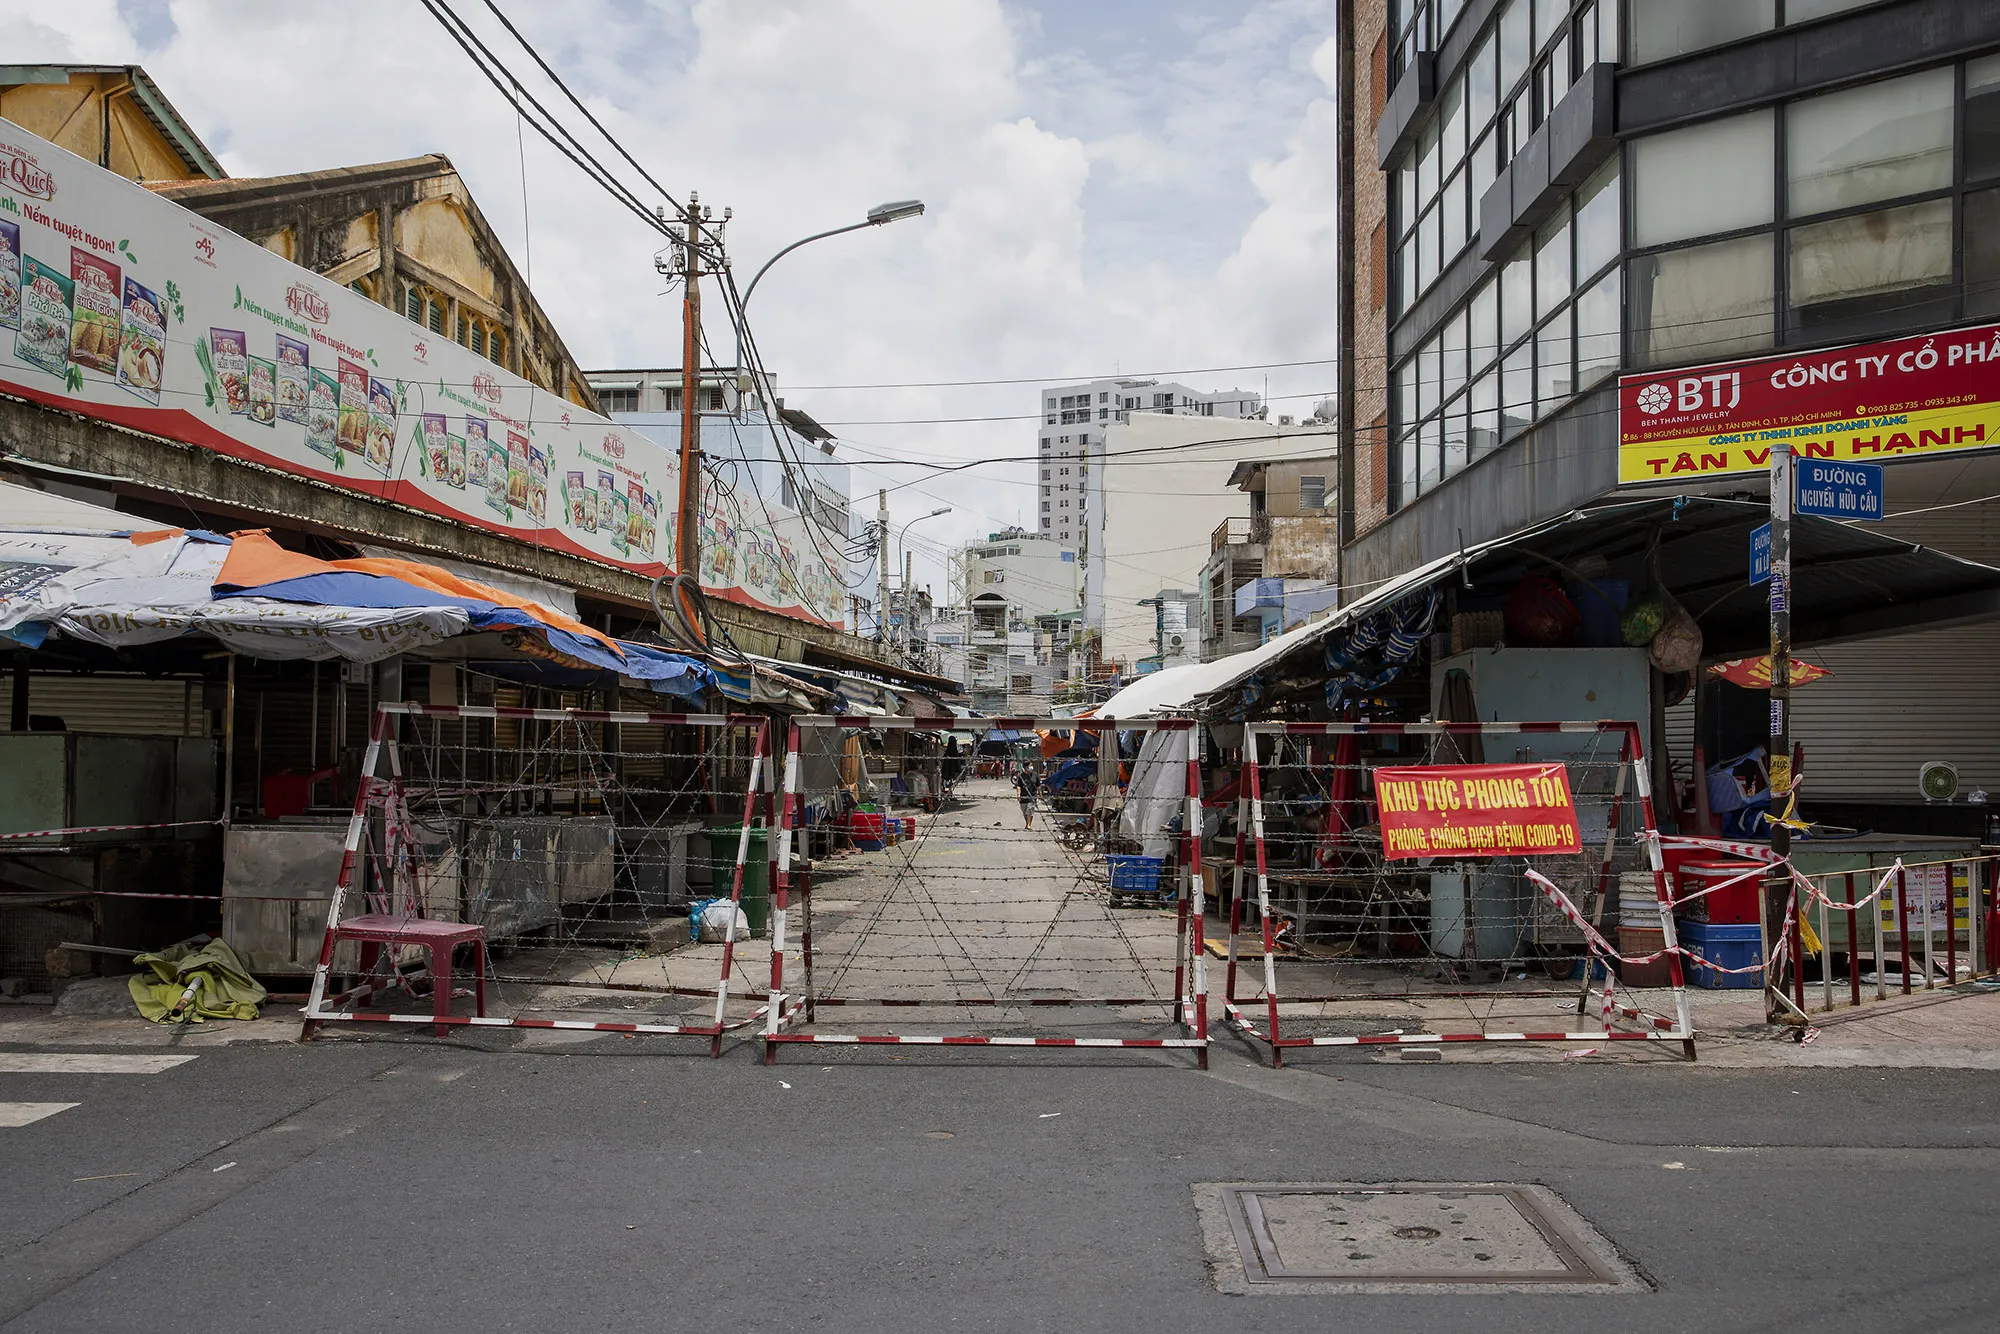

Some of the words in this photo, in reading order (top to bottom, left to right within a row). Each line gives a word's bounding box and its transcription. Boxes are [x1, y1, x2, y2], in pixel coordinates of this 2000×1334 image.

[0, 196, 20, 216] nh,
[24, 203, 50, 228] Nếm
[52, 218, 83, 242] tuyệt
[85, 232, 115, 254] ngon!
[244, 298, 262, 316] Nêm
[263, 308, 283, 327] tuyệt
[311, 328, 327, 344] Nếm
[1770, 361, 1847, 389] CÔNG
[1855, 354, 1890, 378] TY
[1897, 338, 1938, 372] CỔ
[1677, 371, 1740, 412] BTJ
[1868, 405, 1888, 414] 0903
[1889, 403, 1903, 411] 825
[1905, 401, 1918, 409] 735
[1925, 398, 1944, 407] 0935
[1946, 396, 1960, 404] 343
[1963, 394, 1977, 402] 491
[1660, 416, 1689, 424] THANH
[1692, 411, 1730, 421] JEWELRY
[1709, 434, 1741, 446] CÔNG
[1743, 433, 1758, 442] TY
[1759, 429, 1791, 440] TNHH
[1794, 424, 1823, 437] KINH
[1826, 418, 1870, 433] DOANH
[1873, 414, 1908, 427] VÀNG
[1763, 418, 1771, 426] Q.
[1780, 416, 1790, 424] TP.
[1806, 411, 1818, 420] CHÍ
[1821, 410, 1842, 418] MINH
[1646, 452, 1727, 475] TÂN
[1853, 424, 1985, 454] HẠNH
[1813, 467, 1866, 486] ĐƯỜNG
[1801, 486, 1834, 508] NGUYỄN
[1839, 488, 1856, 510] HỮU
[1860, 490, 1877, 512] CẦU
[1379, 780, 1419, 813] KHU
[1421, 776, 1459, 818] VỰC
[1462, 777, 1528, 810] PHONG
[1529, 767, 1569, 809] TỎA
[1388, 823, 1430, 852] PHÒNG,
[1431, 819, 1467, 849] CHỐNG
[1469, 826, 1494, 853] DỊCH
[1495, 821, 1525, 852] BỆNH
[1526, 823, 1575, 847] COVID-19
